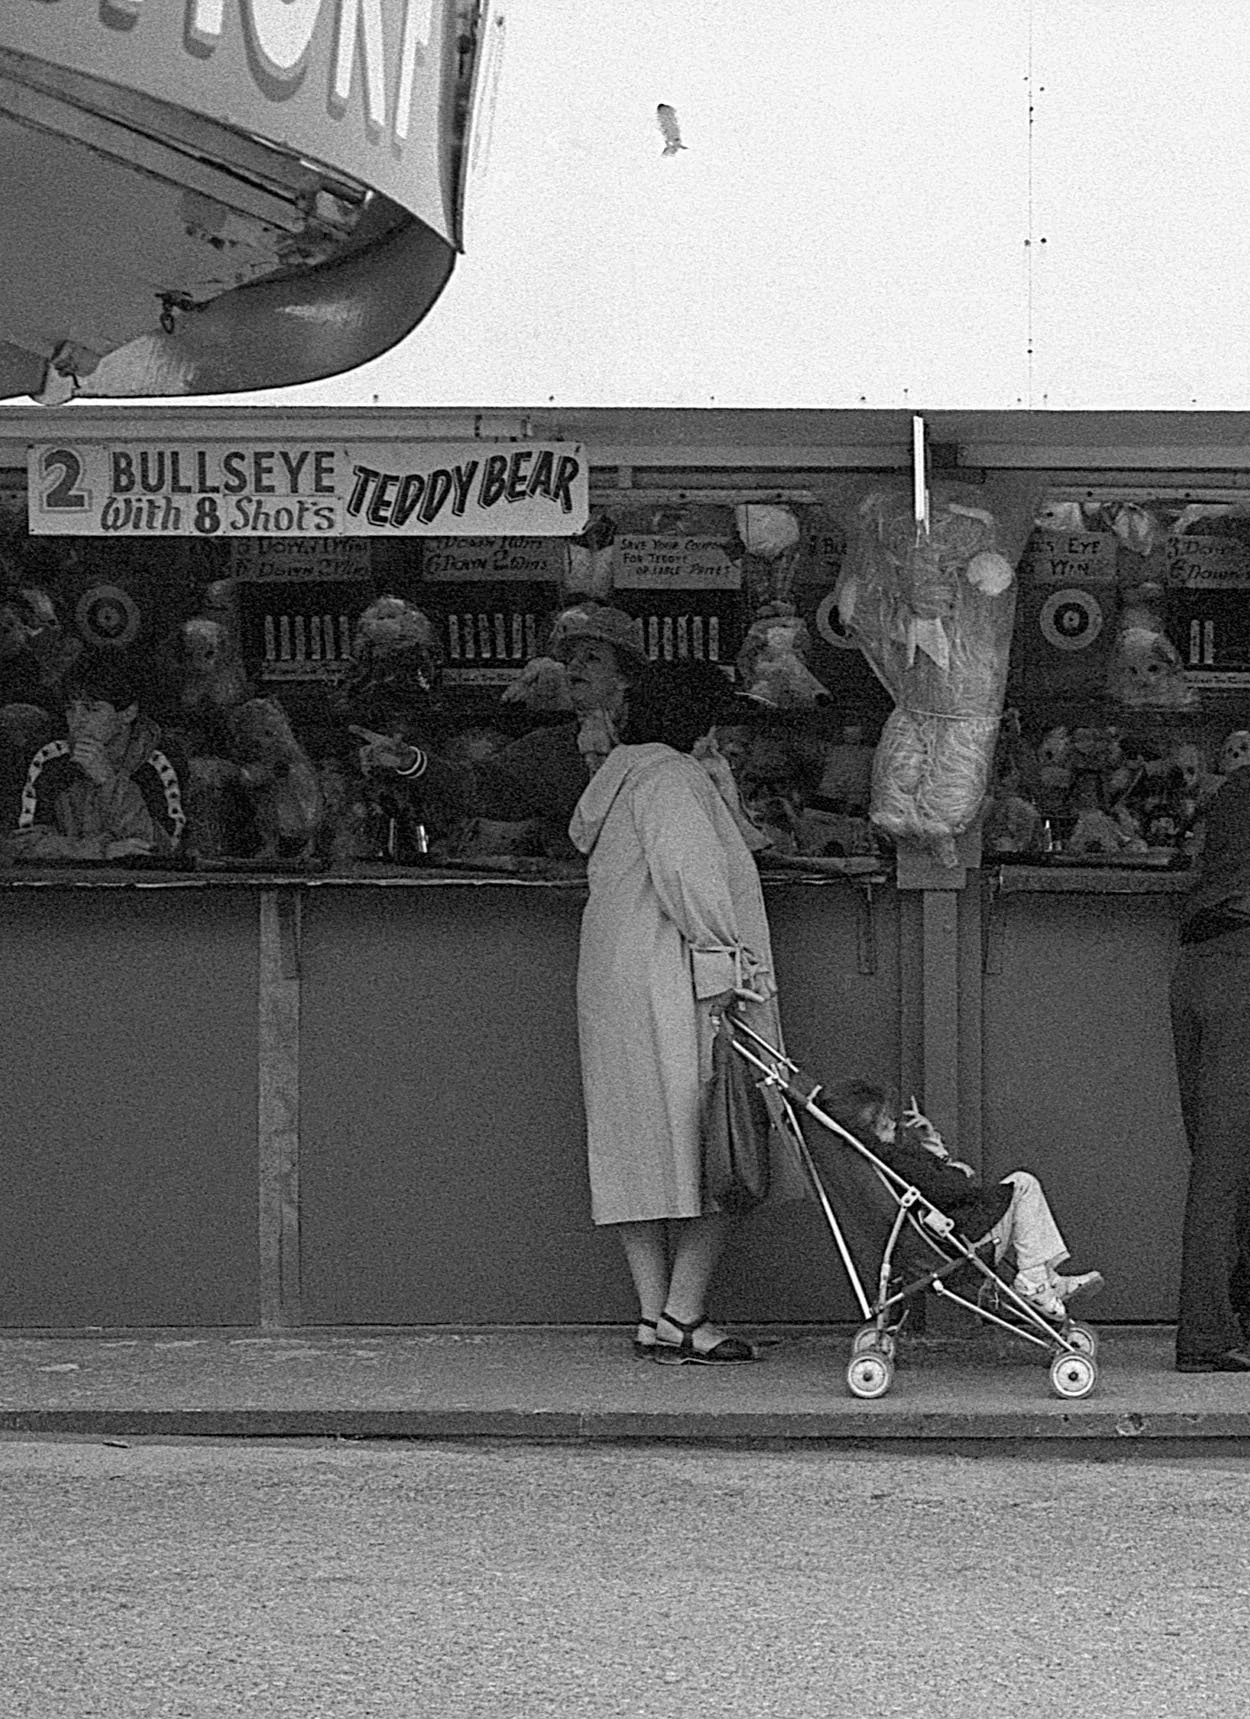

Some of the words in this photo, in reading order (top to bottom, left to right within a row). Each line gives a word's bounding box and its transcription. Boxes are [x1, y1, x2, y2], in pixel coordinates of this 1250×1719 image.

[44, 449, 86, 508] 2
[111, 450, 335, 493] BULLSEYE
[347, 460, 479, 528] TEDDY
[477, 450, 579, 514] BEAR
[100, 496, 181, 531] With
[194, 496, 221, 534] 8
